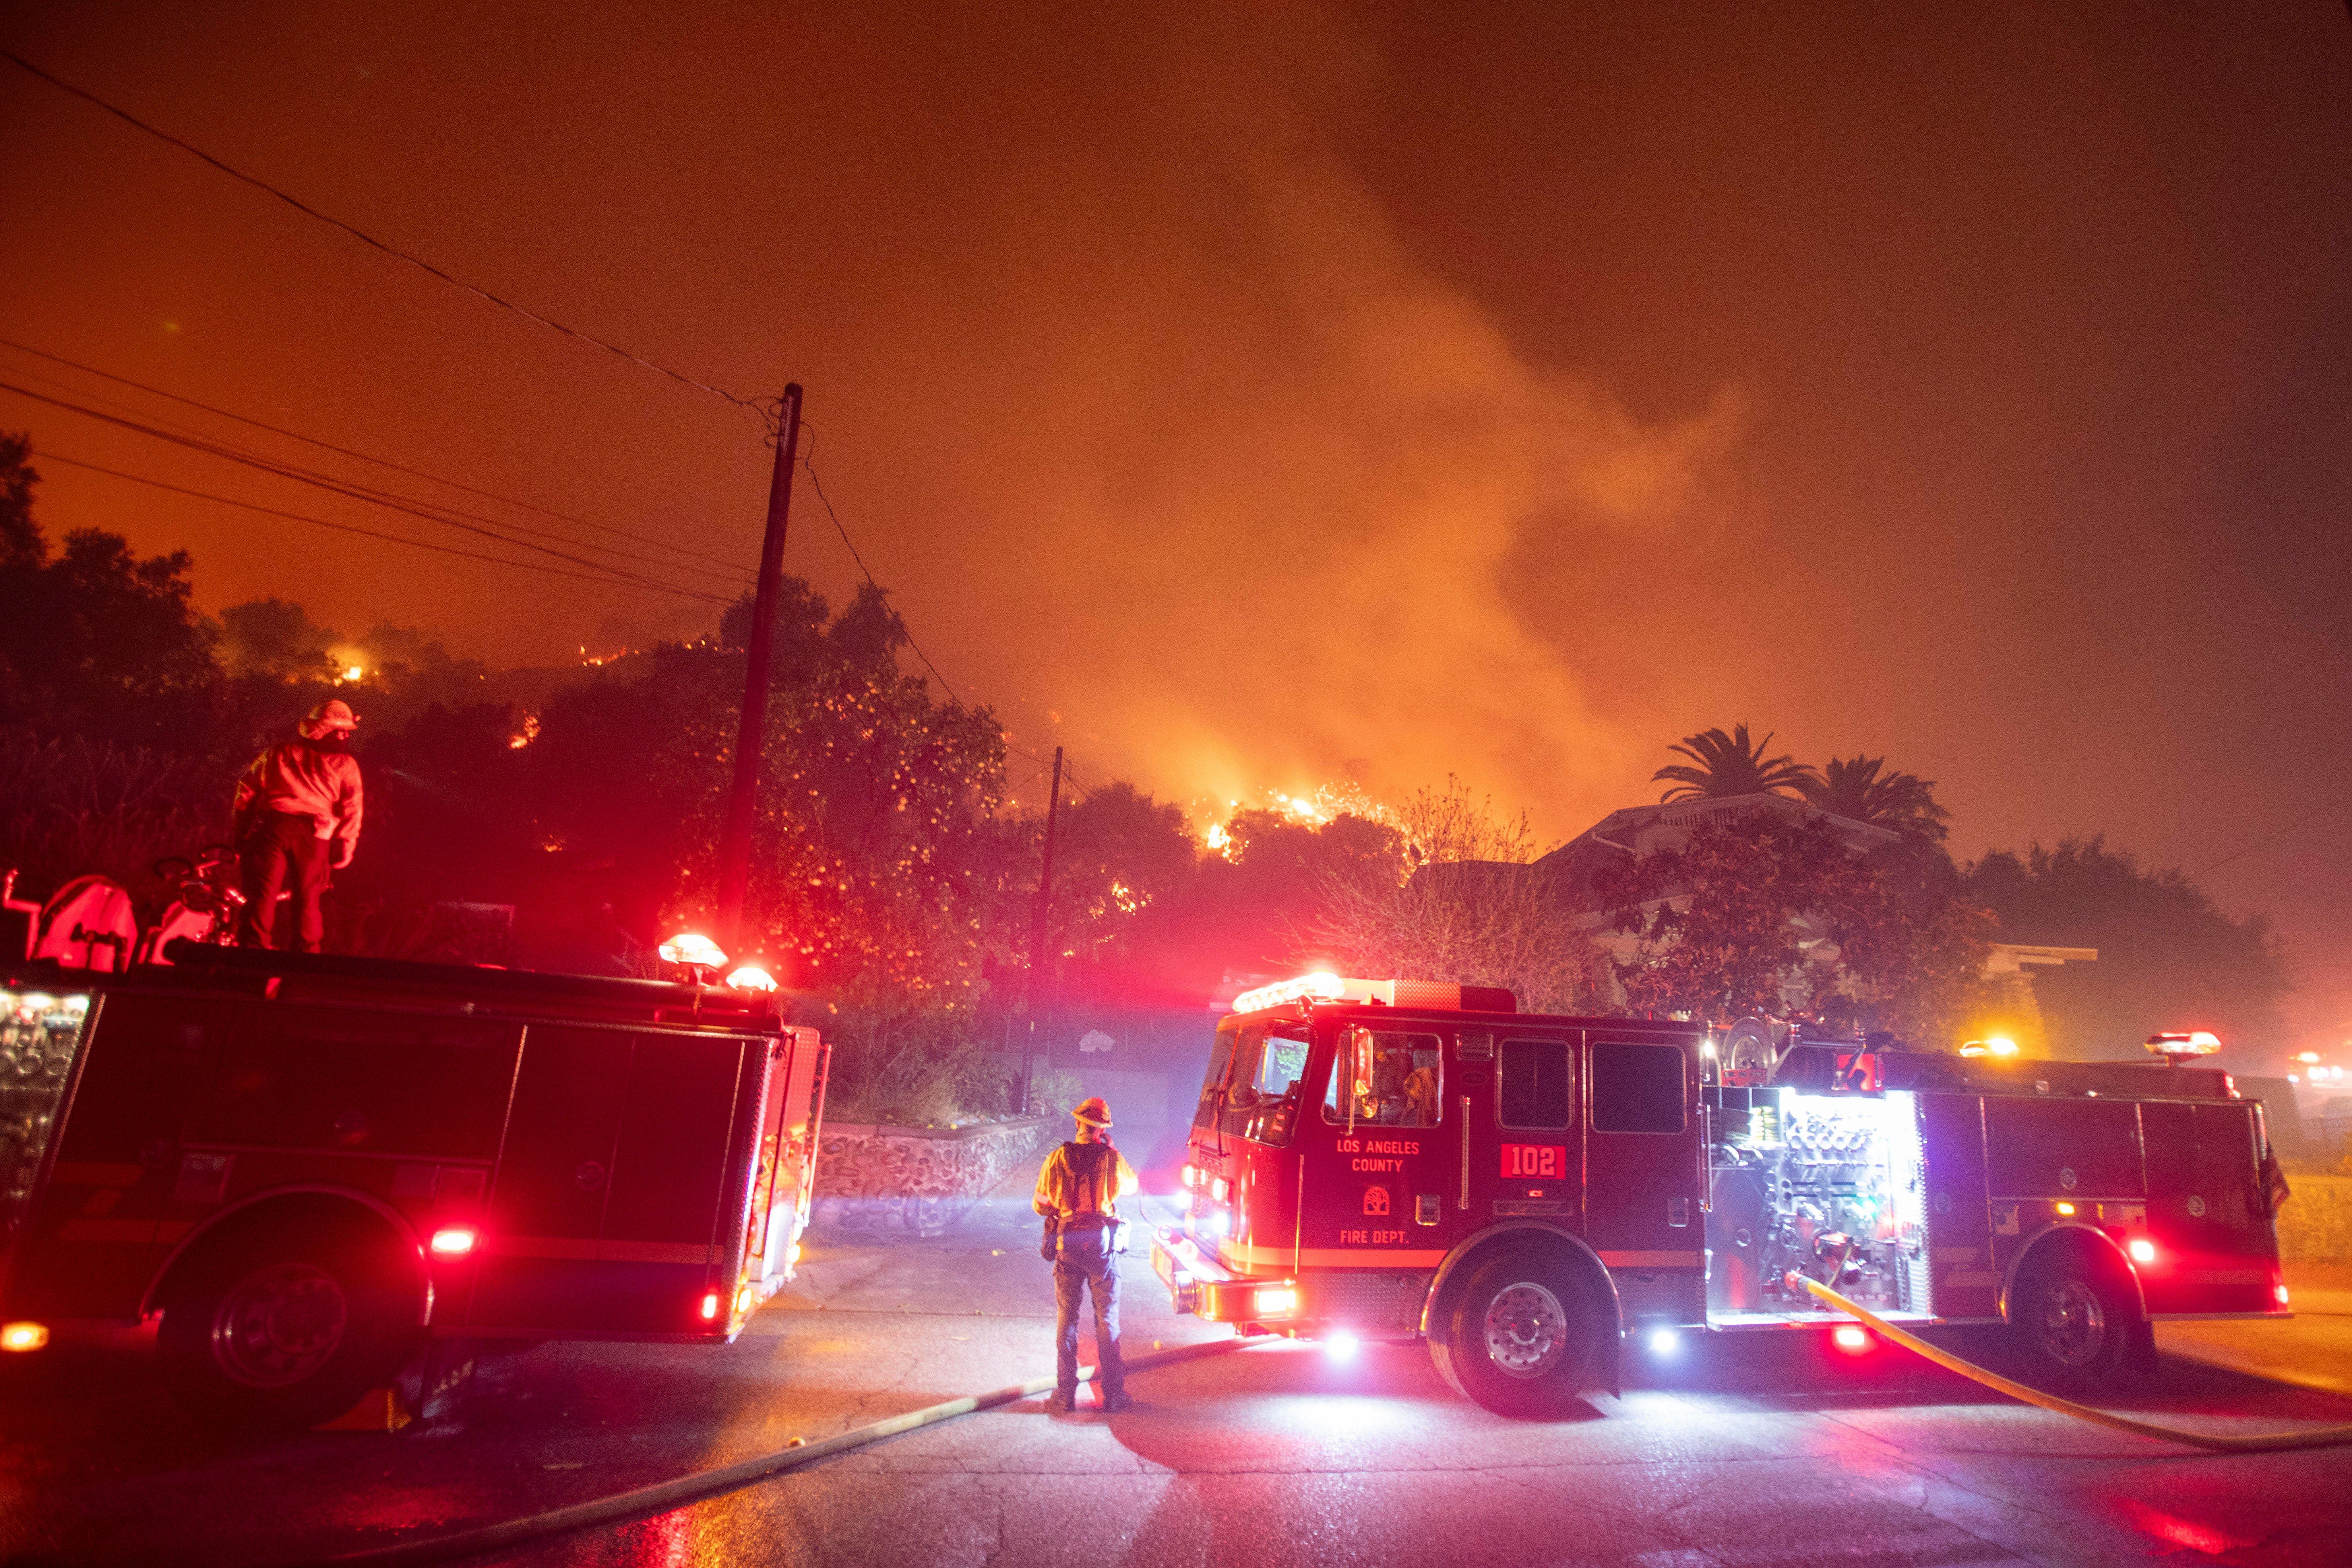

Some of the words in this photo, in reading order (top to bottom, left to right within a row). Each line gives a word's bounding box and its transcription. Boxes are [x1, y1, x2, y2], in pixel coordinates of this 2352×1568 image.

[1337, 1140, 1360, 1152] LOS
[1366, 1140, 1419, 1154] ANGELES
[1352, 1159, 1403, 1172] COUNTY
[1512, 1146, 1555, 1176] 102
[1340, 1230, 1368, 1243] FIRE
[1373, 1230, 1410, 1244] DEPT.
